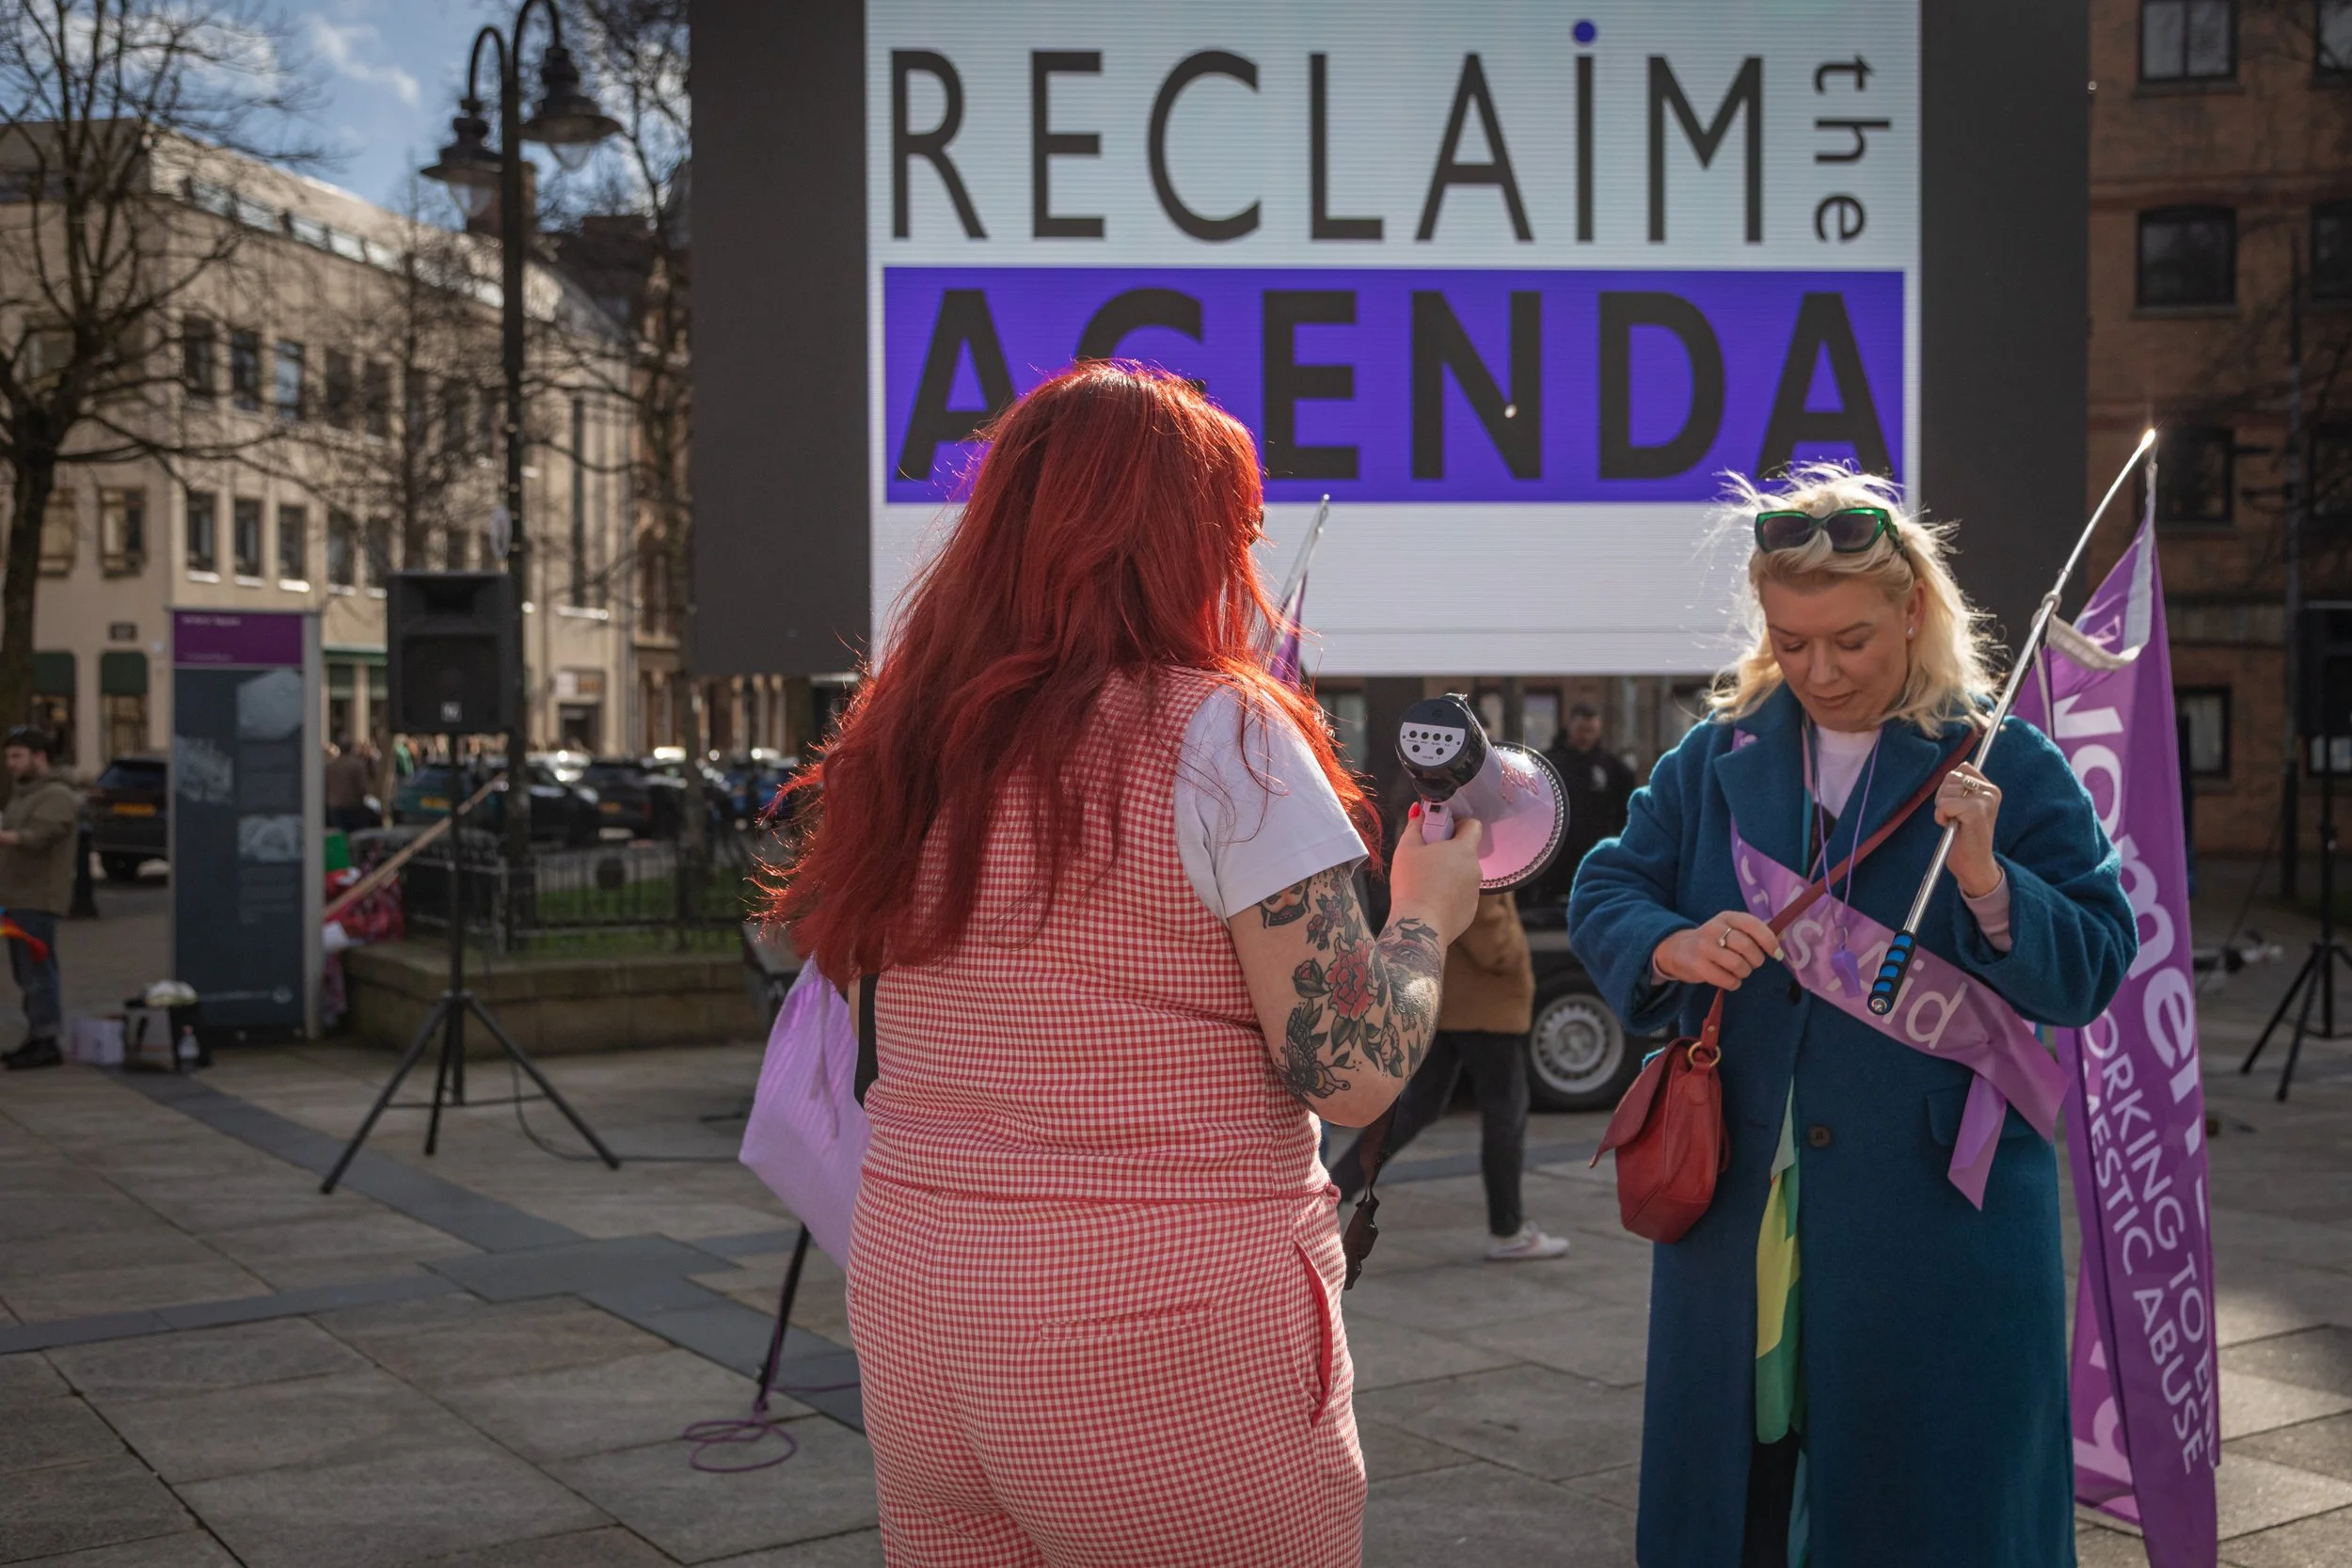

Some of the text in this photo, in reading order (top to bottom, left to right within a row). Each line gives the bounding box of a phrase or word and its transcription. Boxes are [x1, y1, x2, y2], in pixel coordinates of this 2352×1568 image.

[1813, 54, 1891, 243] the
[2084, 1009, 2186, 1251] ORKING
[2169, 1251, 2205, 1344] TO
[2133, 1288, 2204, 1476] ABUSE
